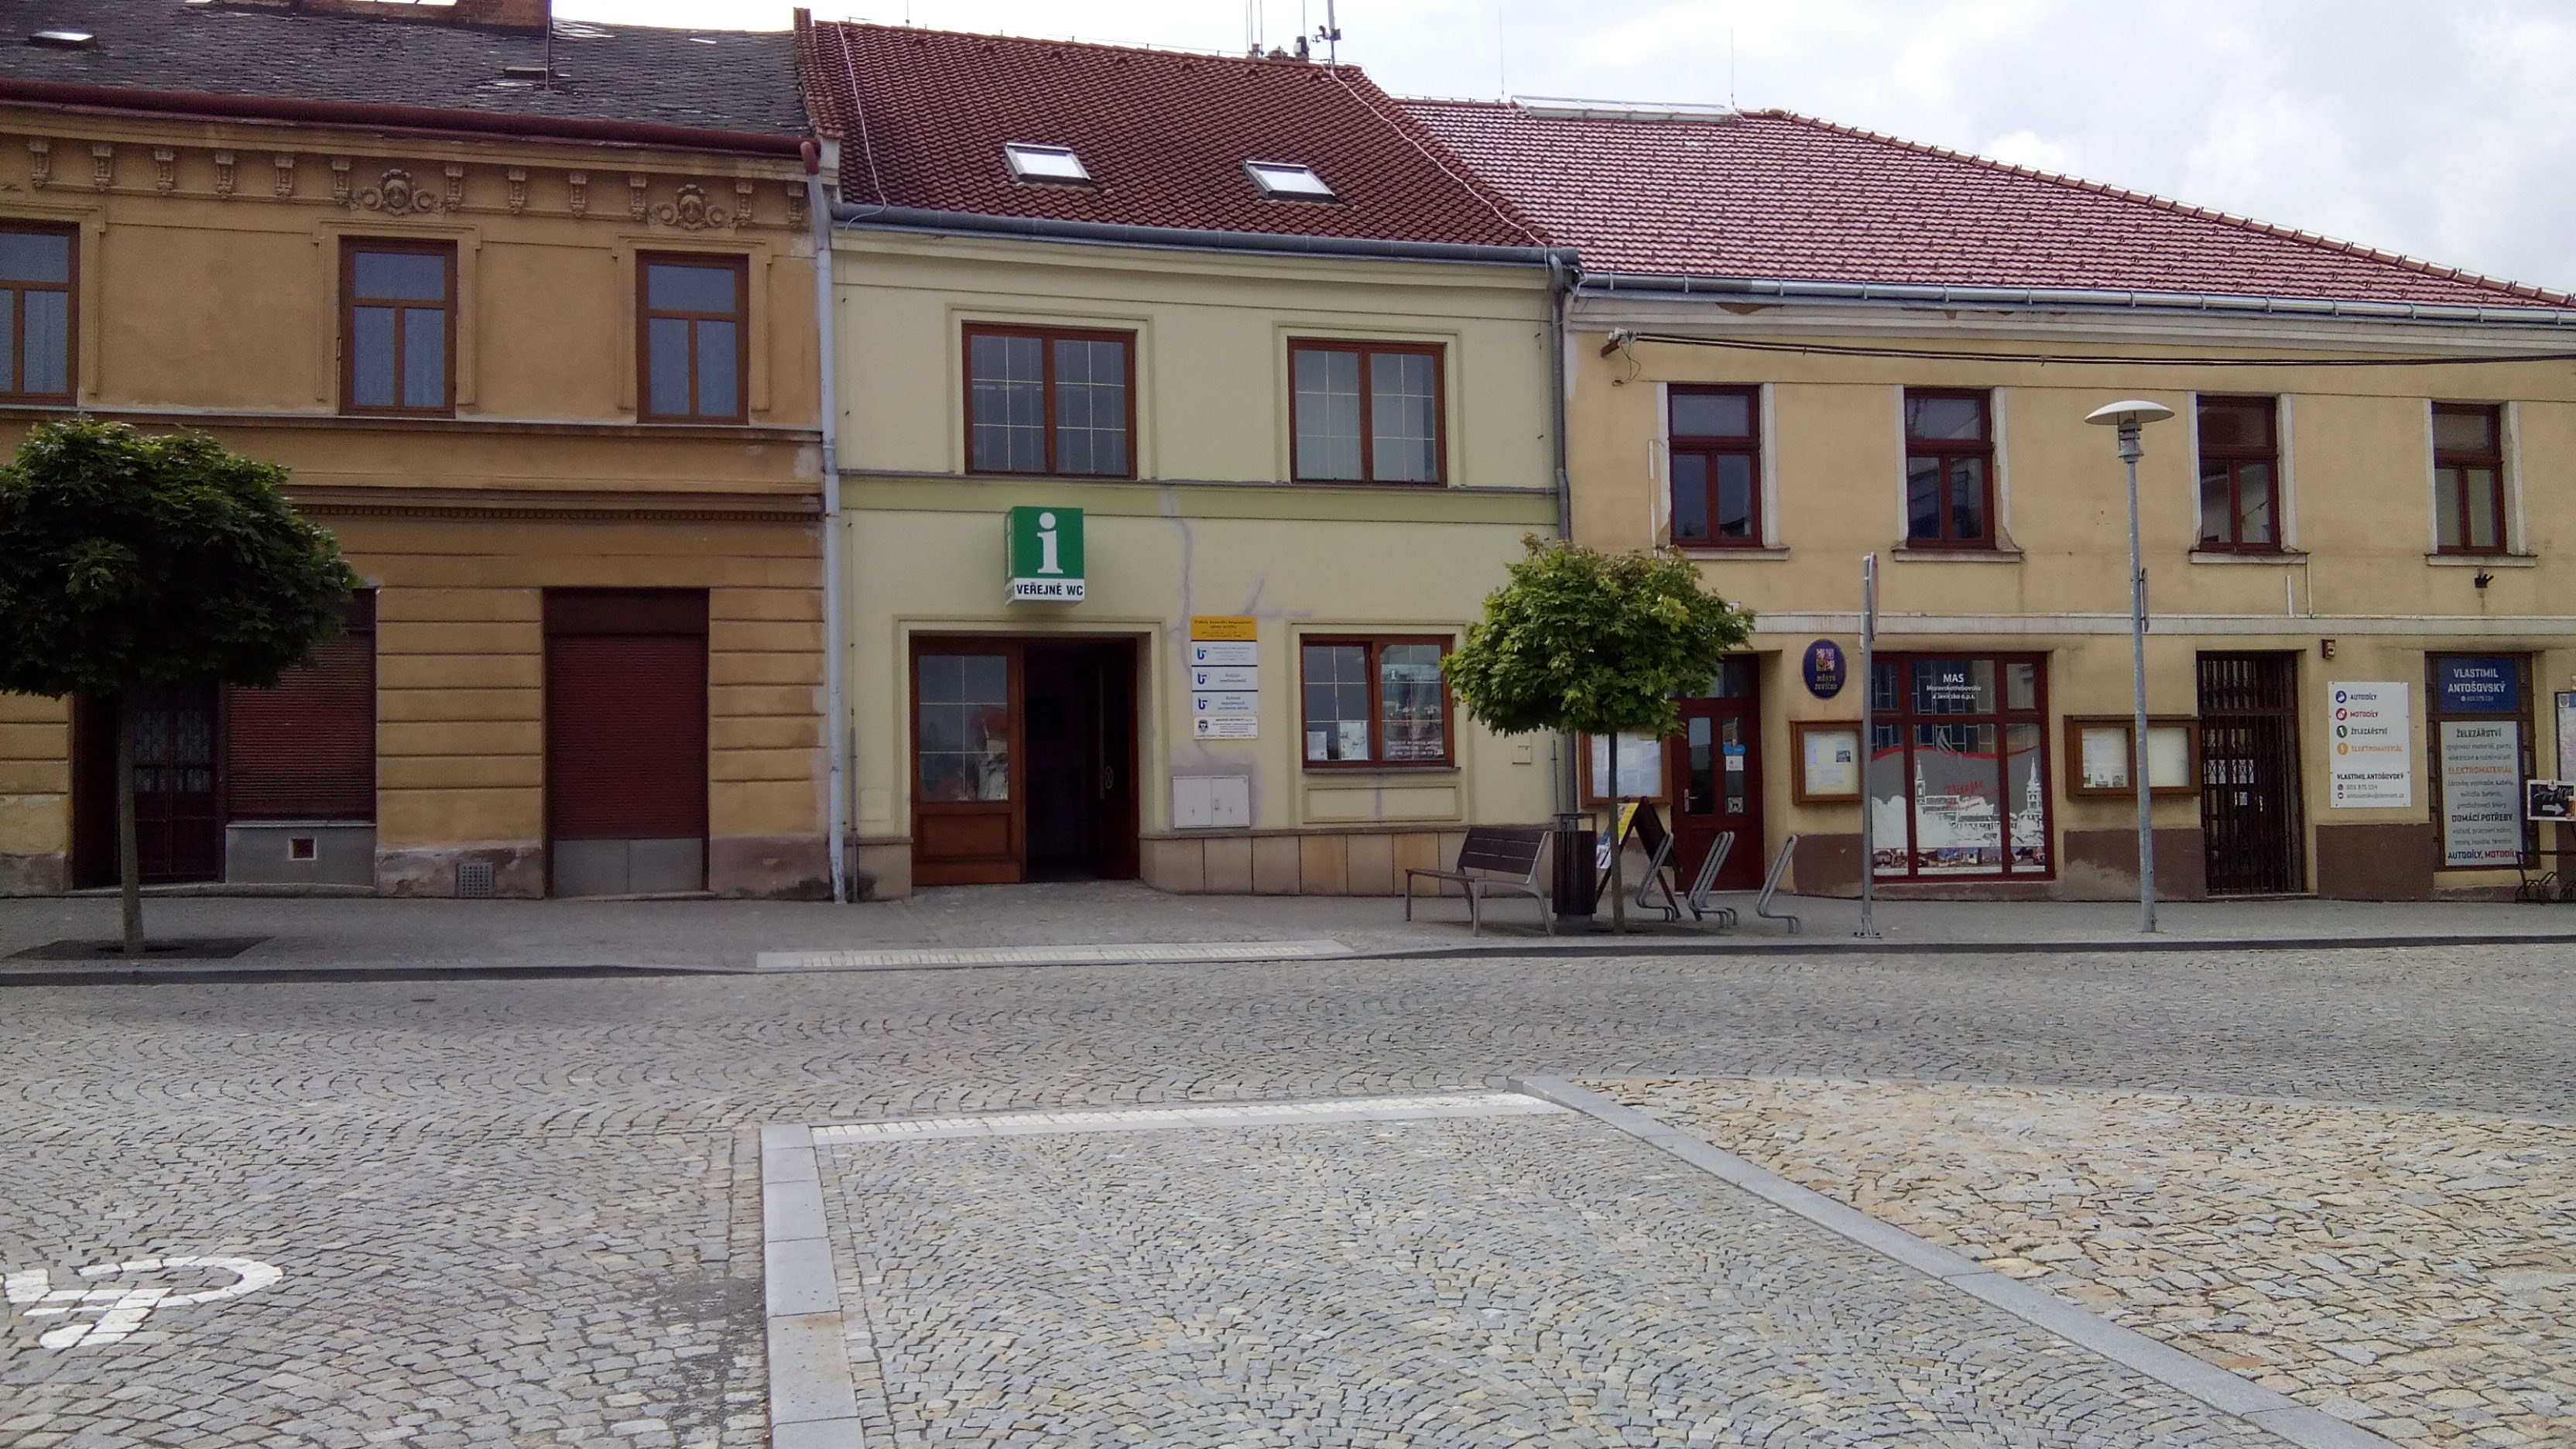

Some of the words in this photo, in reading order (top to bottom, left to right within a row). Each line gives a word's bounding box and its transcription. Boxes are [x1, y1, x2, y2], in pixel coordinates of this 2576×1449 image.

[1016, 582, 1062, 595] VEŘEJNÉ
[1066, 585, 1083, 595] WC
[1943, 673, 1964, 683] MAS
[2453, 668, 2499, 678] VLASTIMIL
[2448, 680, 2506, 693] ANTOŠOVSKÝ
[2350, 692, 2377, 701] AUTODÍLY
[2350, 709, 2379, 718] MOTODÍLY
[2351, 726, 2388, 735] ŽELEZÁŘSTVÍ
[2456, 728, 2502, 738] ŽELEZÁŘSTVÍ
[2448, 765, 2513, 775] ELEKTROMATERIÁL
[2451, 813, 2479, 822] DOMÁCÍ
[2481, 812, 2513, 821] POTŘEBY
[2448, 849, 2484, 860] AUTODÍLY,
